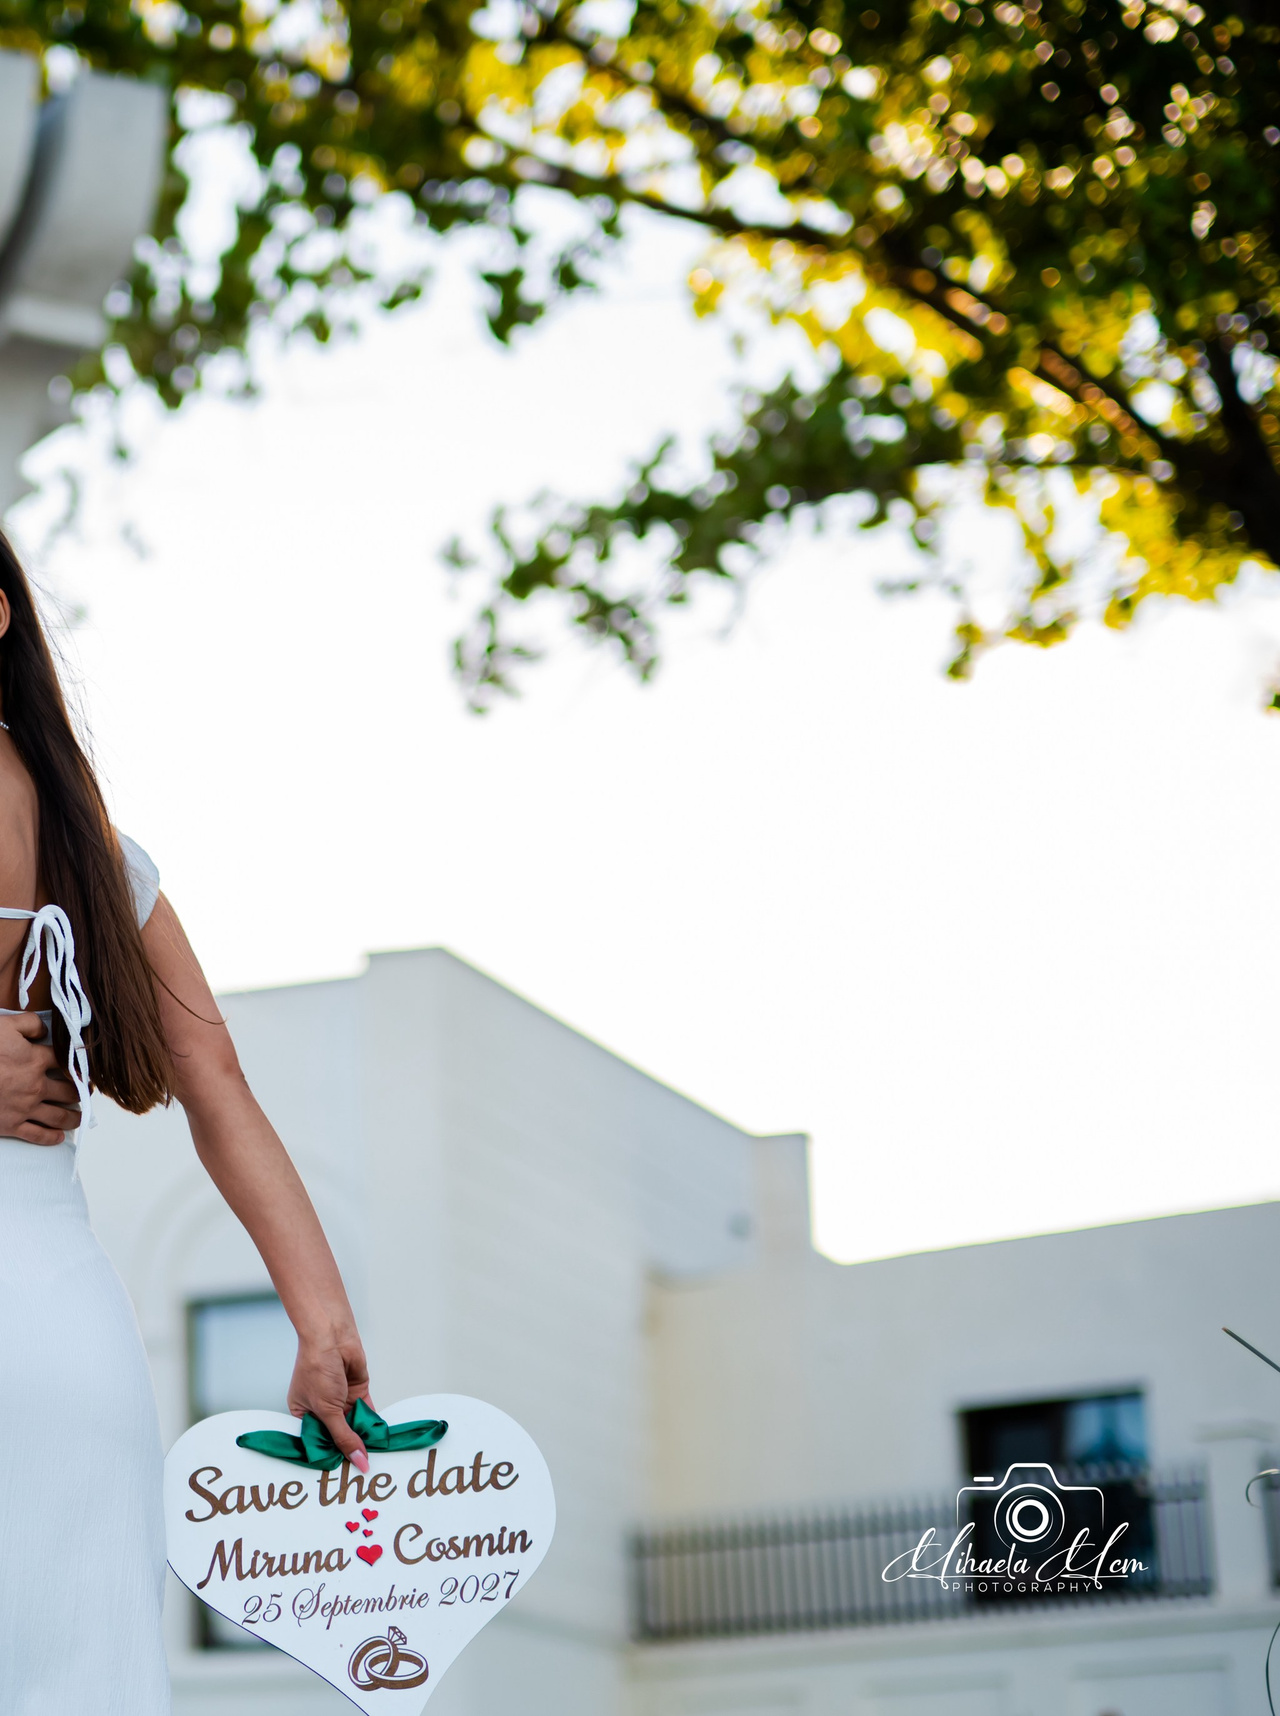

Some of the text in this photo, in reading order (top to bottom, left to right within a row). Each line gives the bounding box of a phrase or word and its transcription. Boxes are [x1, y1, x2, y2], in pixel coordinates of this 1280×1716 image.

[185, 1448, 520, 1523] Save the date
[196, 1523, 533, 1590] Miruna Cosmin
[241, 1569, 520, 1631] 25 Septembrie 2027
